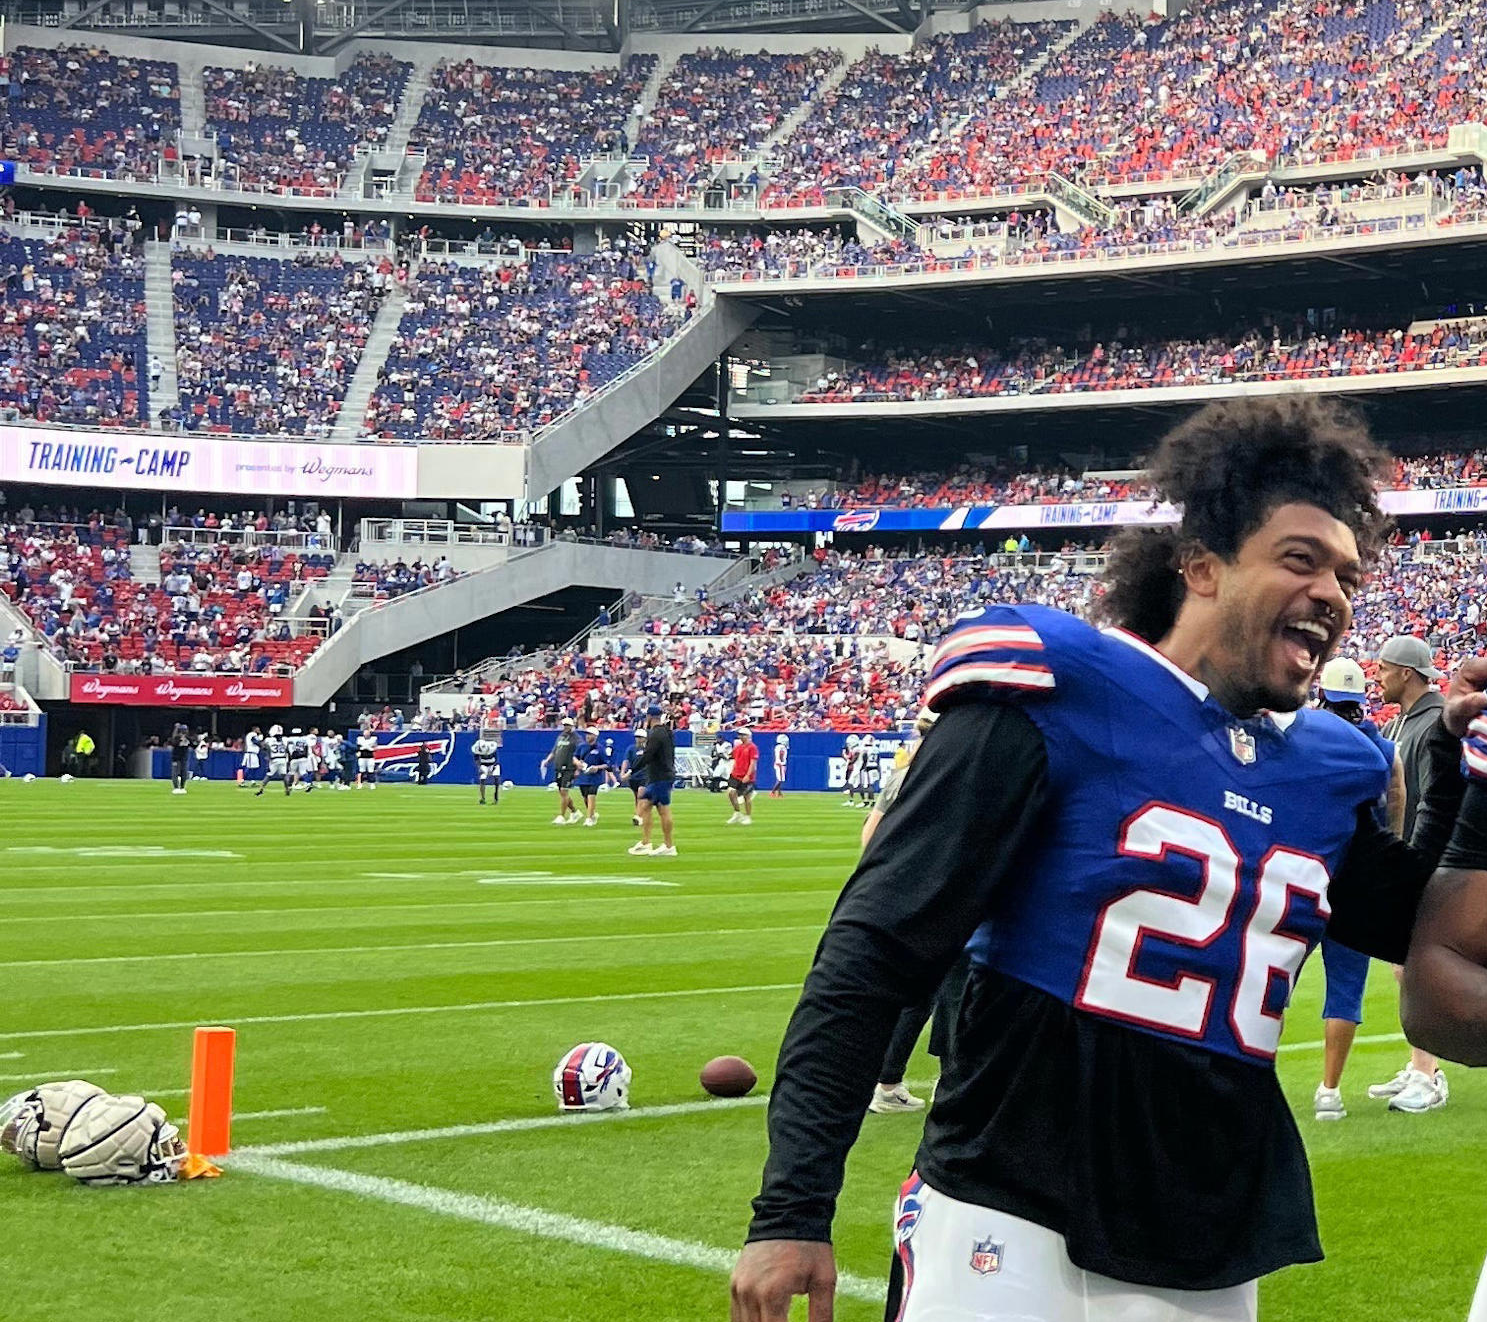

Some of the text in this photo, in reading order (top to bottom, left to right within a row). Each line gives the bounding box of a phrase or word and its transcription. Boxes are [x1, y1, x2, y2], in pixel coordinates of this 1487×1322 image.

[28, 441, 119, 474] TRAINING
[135, 448, 191, 478] CAMP
[300, 457, 376, 482] Wegmans
[1434, 489, 1482, 509] TRAINING
[1040, 506, 1083, 524] TRAINING
[1091, 504, 1118, 522] CAMP
[82, 678, 282, 702] Wegmans Wegmans Wegmans
[1224, 790, 1273, 825] BILLS
[1074, 800, 1333, 1059] 26
